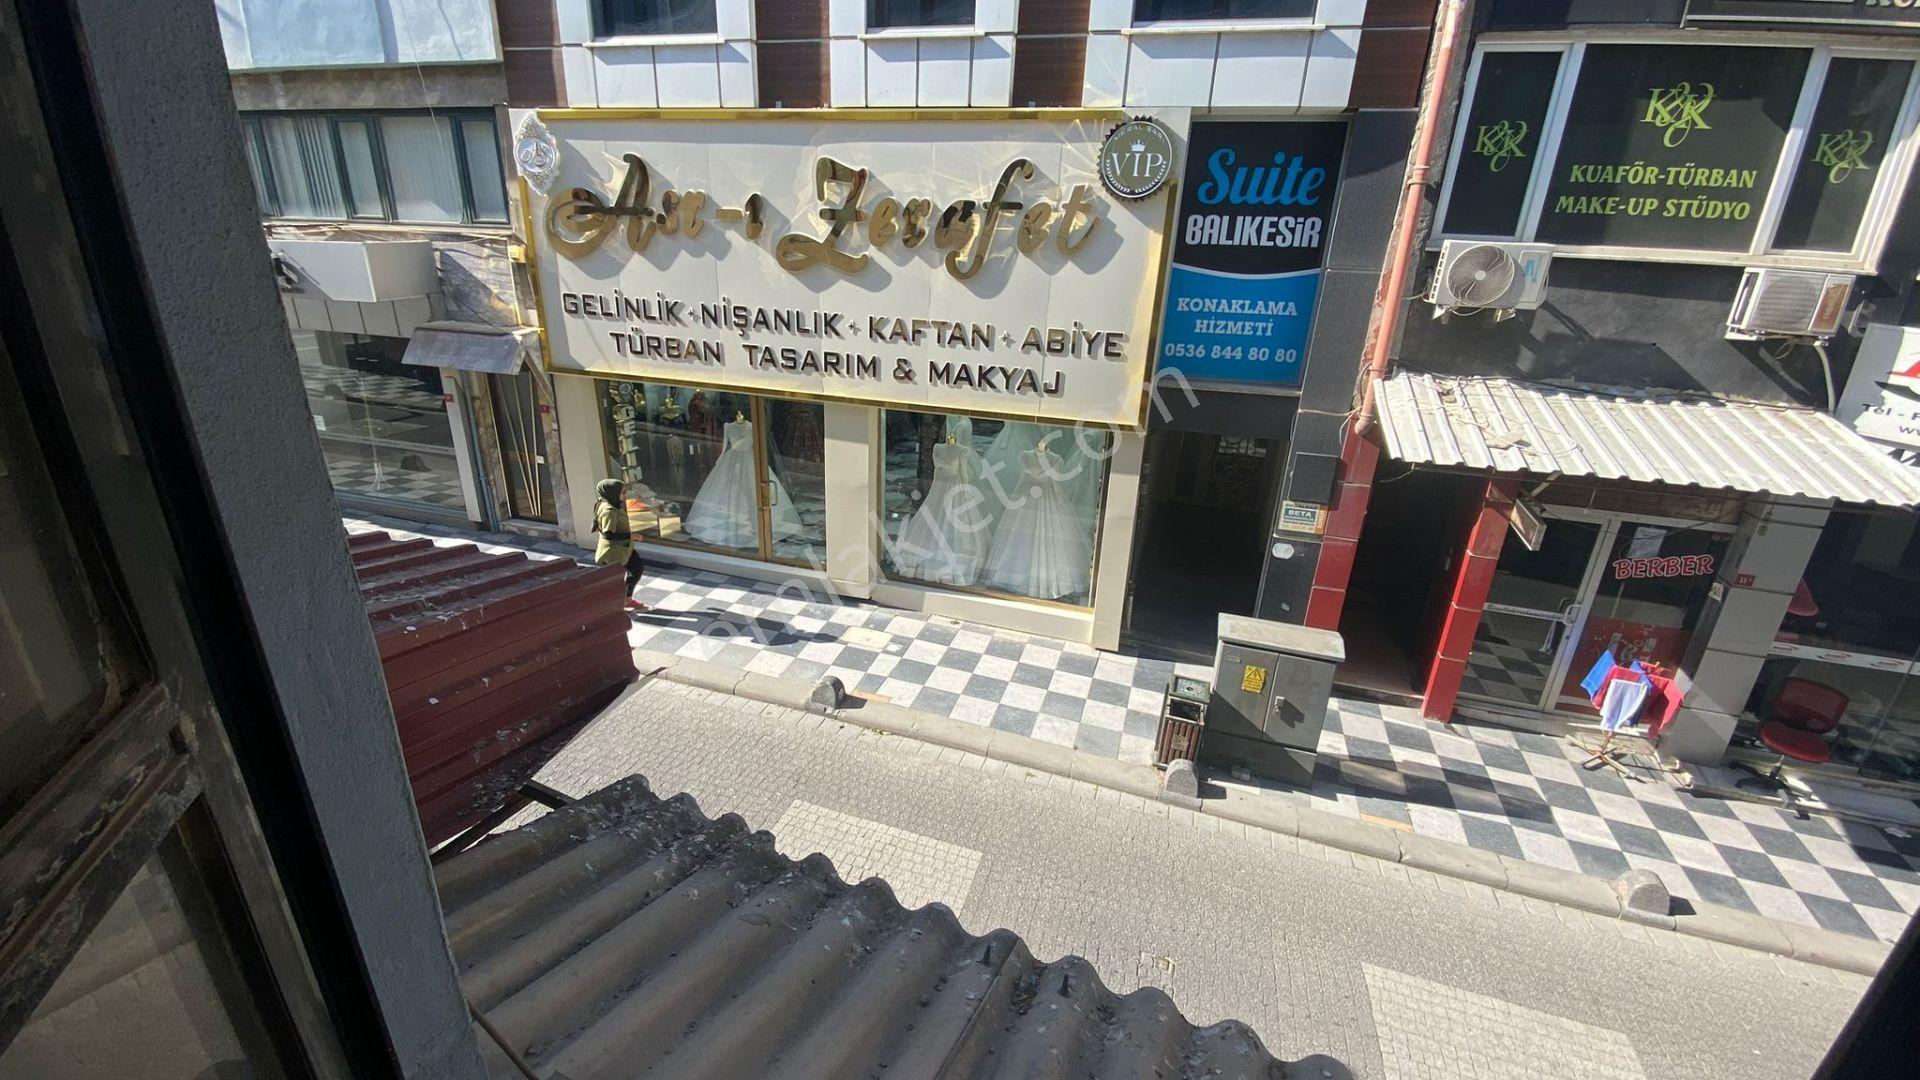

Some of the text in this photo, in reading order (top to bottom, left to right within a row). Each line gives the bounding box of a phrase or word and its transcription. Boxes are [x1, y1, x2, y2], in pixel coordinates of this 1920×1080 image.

[1110, 153, 1163, 177] VIP
[1198, 148, 1326, 206] Suite
[776, 156, 1100, 280] Zerafet
[1555, 195, 1750, 220] MAKE-UP STÜDYO
[1177, 297, 1298, 316] KONAKLAMA
[562, 289, 1124, 358] GELİNLİK NİŞANLIK KAFTAN ABİYE
[1194, 316, 1274, 336] HİZMETİ
[609, 327, 1062, 395] TÜRBAN TASARIM & MAKYAJ
[1164, 343, 1297, 363] 0536 844 80 80
[1862, 403, 1892, 416] Tel
[1613, 555, 1714, 580] BERBER
